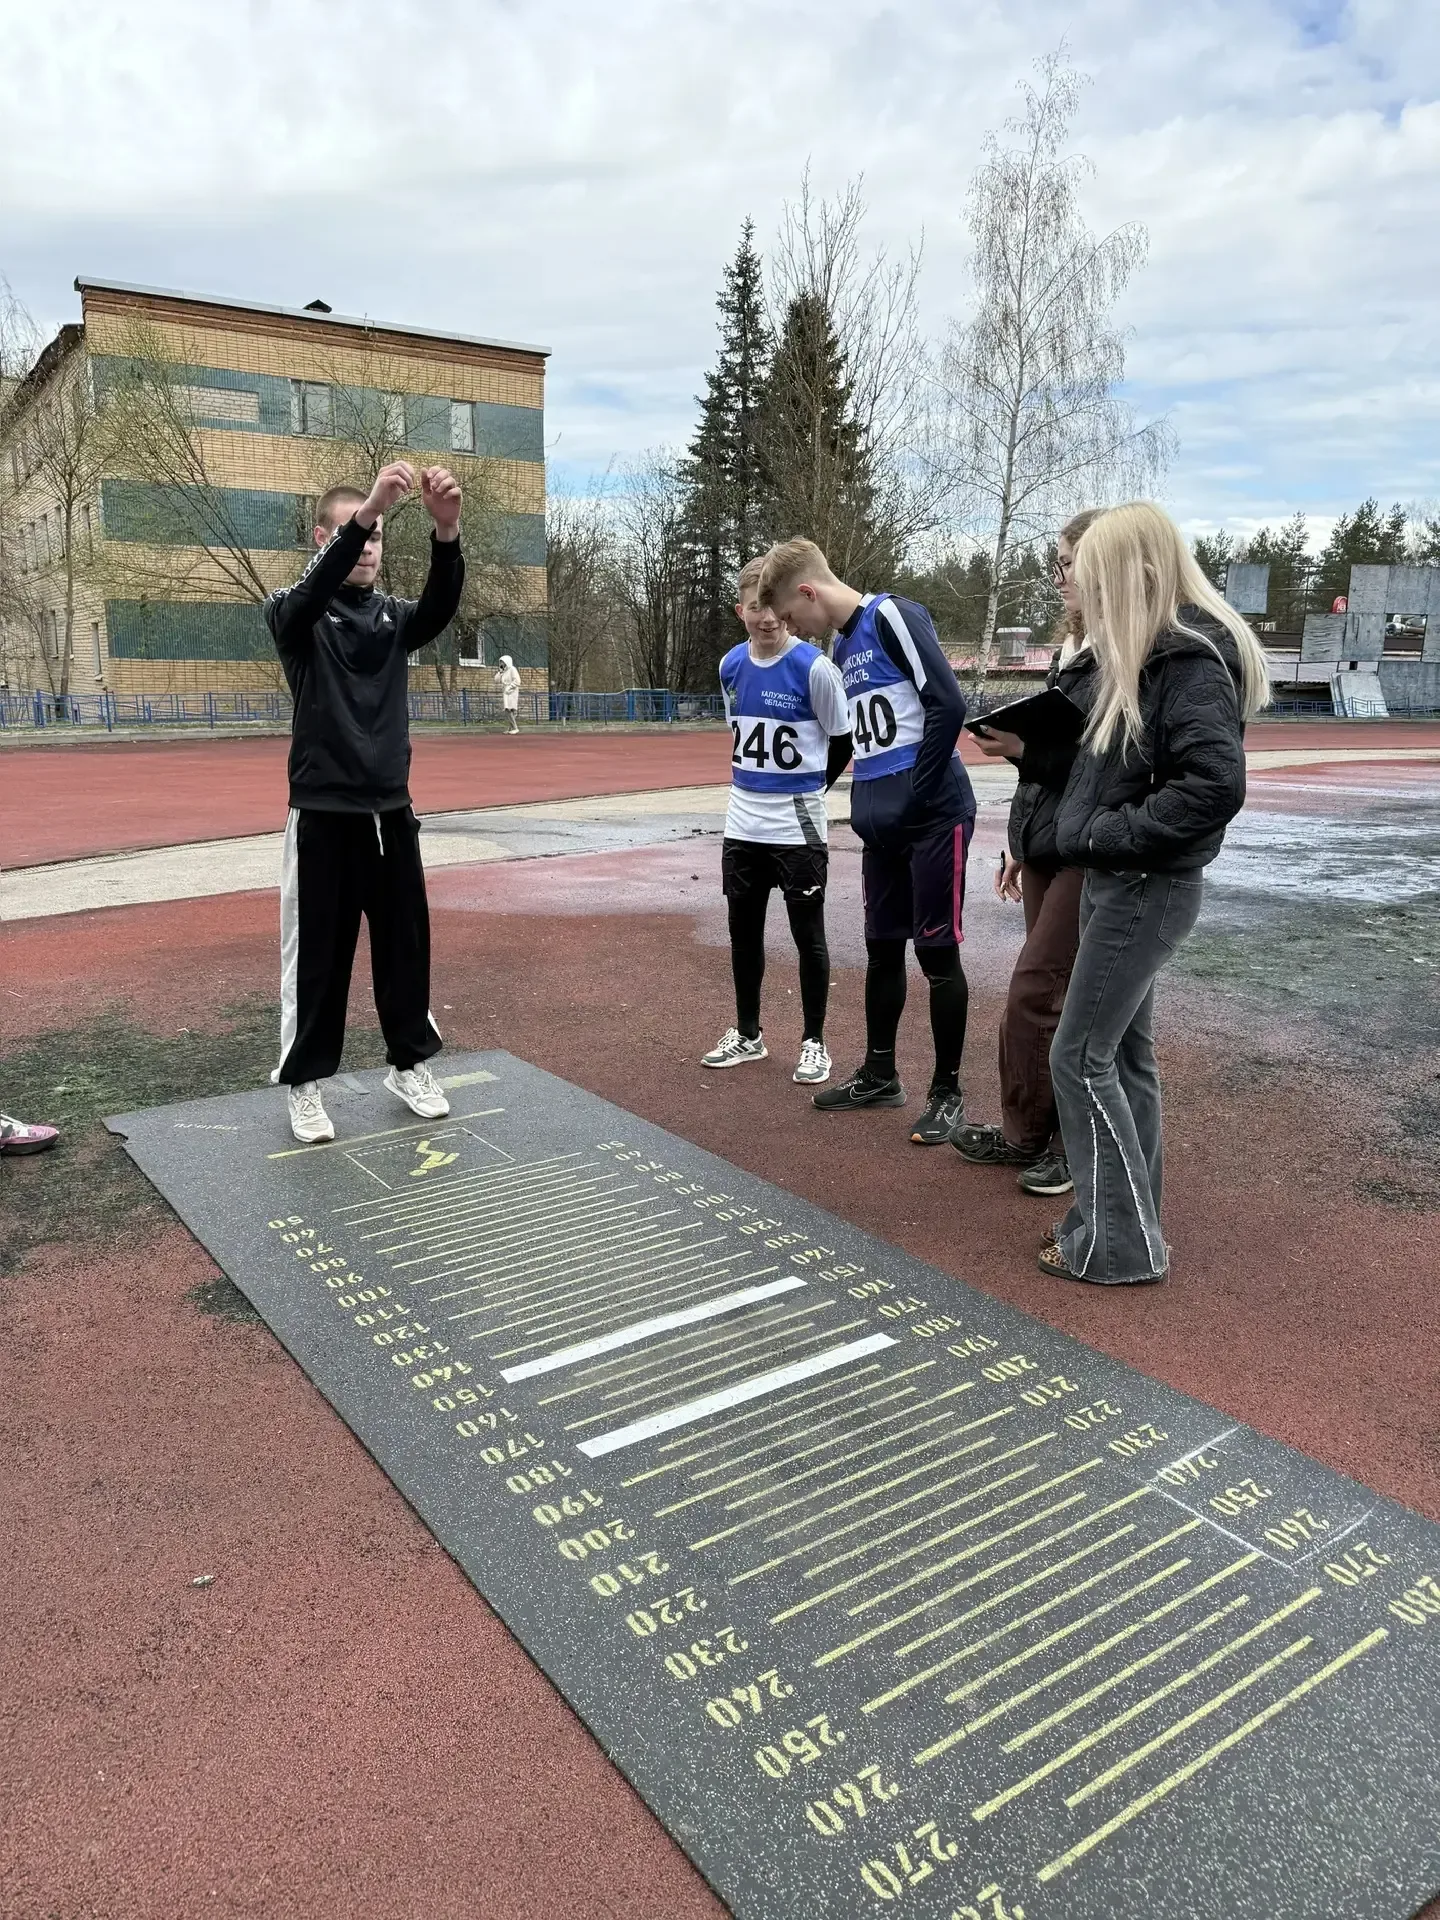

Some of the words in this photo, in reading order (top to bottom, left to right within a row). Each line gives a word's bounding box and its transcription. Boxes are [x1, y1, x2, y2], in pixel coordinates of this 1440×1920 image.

[761, 690, 802, 703] КАЛУЖСКАЯ
[764, 698, 797, 710] ОБЛАСТЬ
[732, 720, 803, 770] 246
[597, 1140, 626, 1151] 50
[615, 1150, 642, 1161] 60
[634, 1161, 664, 1172] 70
[653, 1171, 684, 1183] 80
[675, 1183, 704, 1195] 90
[693, 1193, 735, 1208] 100
[268, 1216, 304, 1229] 50
[715, 1204, 758, 1221] 110
[281, 1229, 315, 1243] 60
[739, 1218, 783, 1235] 120
[296, 1243, 333, 1258] 70
[764, 1232, 809, 1249] 130
[310, 1258, 347, 1272] 80
[790, 1246, 835, 1265] 140
[326, 1272, 364, 1288] 90
[818, 1262, 865, 1282] 150
[338, 1286, 392, 1308] 100
[847, 1278, 896, 1299] 160
[355, 1304, 411, 1326] 110
[877, 1297, 928, 1319] 170
[373, 1322, 431, 1345] 120
[911, 1315, 962, 1337] 180
[391, 1341, 449, 1366] 130
[947, 1334, 999, 1359] 190
[412, 1361, 473, 1388] 140
[981, 1355, 1038, 1382] 200
[434, 1384, 495, 1412] 150
[1020, 1376, 1079, 1406] 210
[456, 1407, 518, 1437] 160
[1064, 1399, 1122, 1431] 220
[480, 1432, 545, 1465] 170
[1108, 1423, 1169, 1457] 230
[506, 1460, 573, 1494] 180
[533, 1489, 603, 1526] 190
[1209, 1478, 1273, 1516] 250
[558, 1519, 636, 1561] 200
[1264, 1508, 1330, 1550] 260
[590, 1551, 670, 1597] 210
[1324, 1542, 1392, 1586] 270
[625, 1587, 707, 1637] 220
[664, 1626, 749, 1680] 230
[705, 1669, 795, 1728] 240
[753, 1714, 846, 1779] 250
[805, 1764, 899, 1836] 260
[860, 1820, 959, 1900] 270
